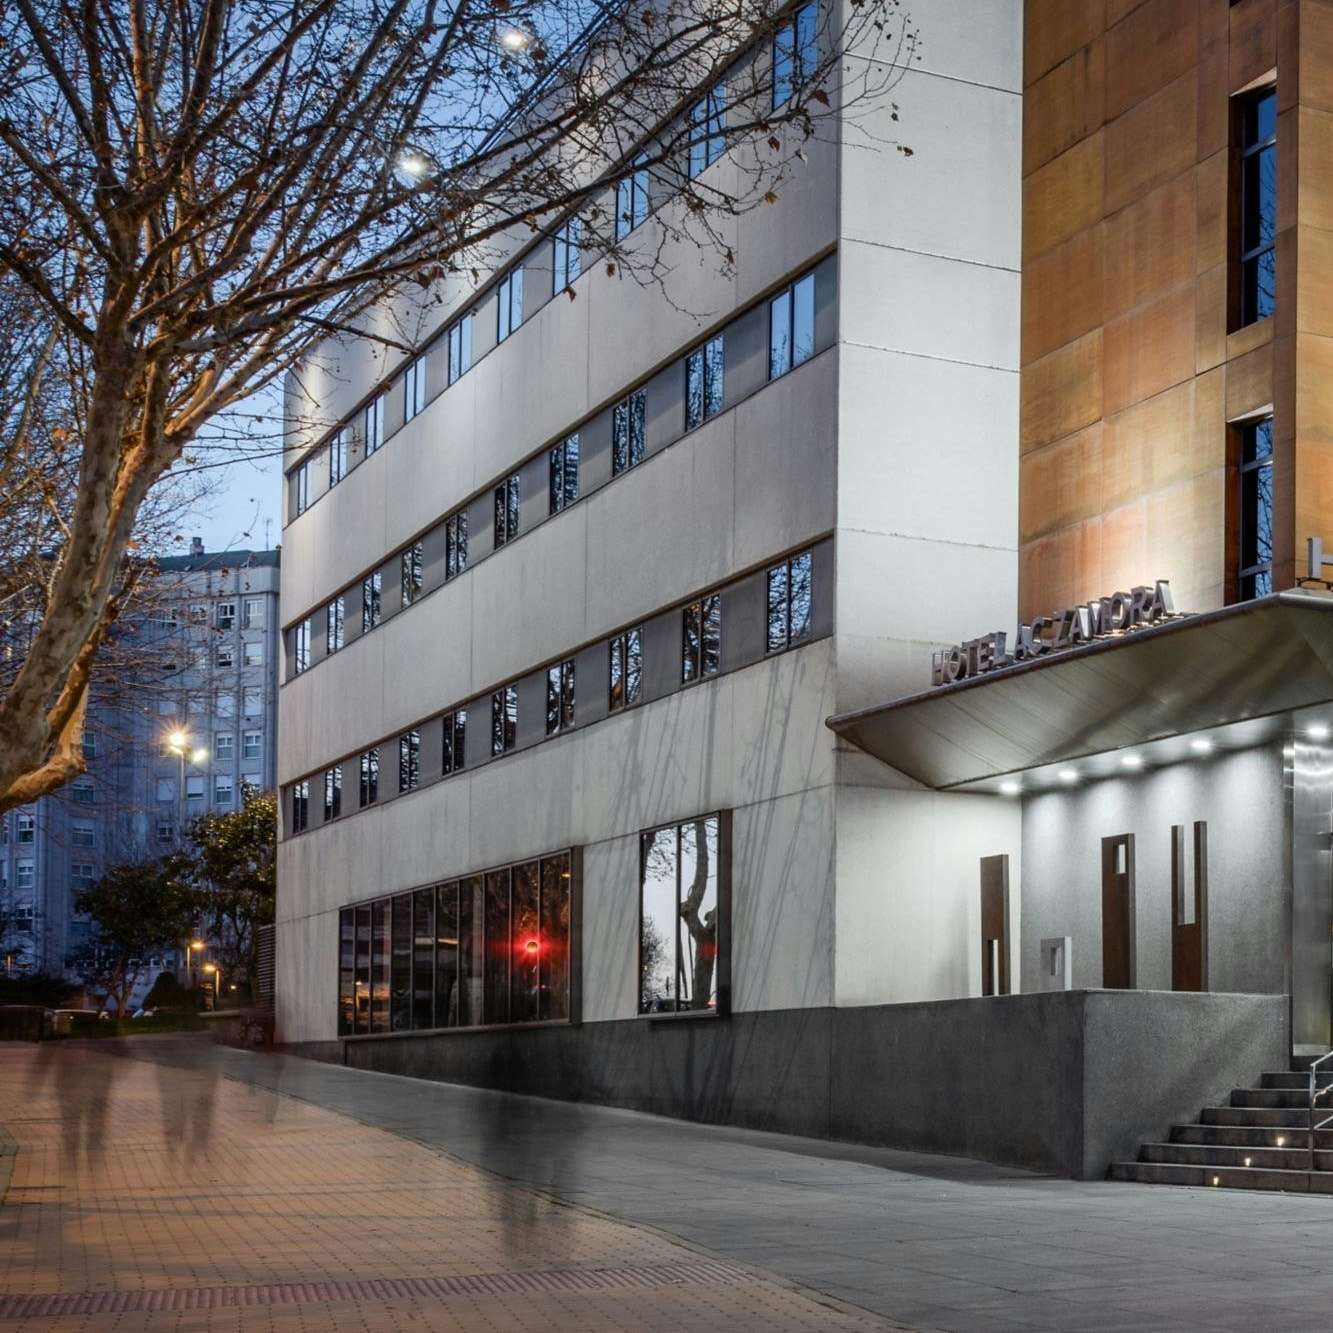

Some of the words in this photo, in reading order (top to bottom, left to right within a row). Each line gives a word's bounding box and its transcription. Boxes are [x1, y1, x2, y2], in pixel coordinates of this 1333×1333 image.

[931, 630, 1007, 686] HOTEL
[1014, 616, 1053, 660] AC
[1050, 579, 1176, 650] ZAMORA
